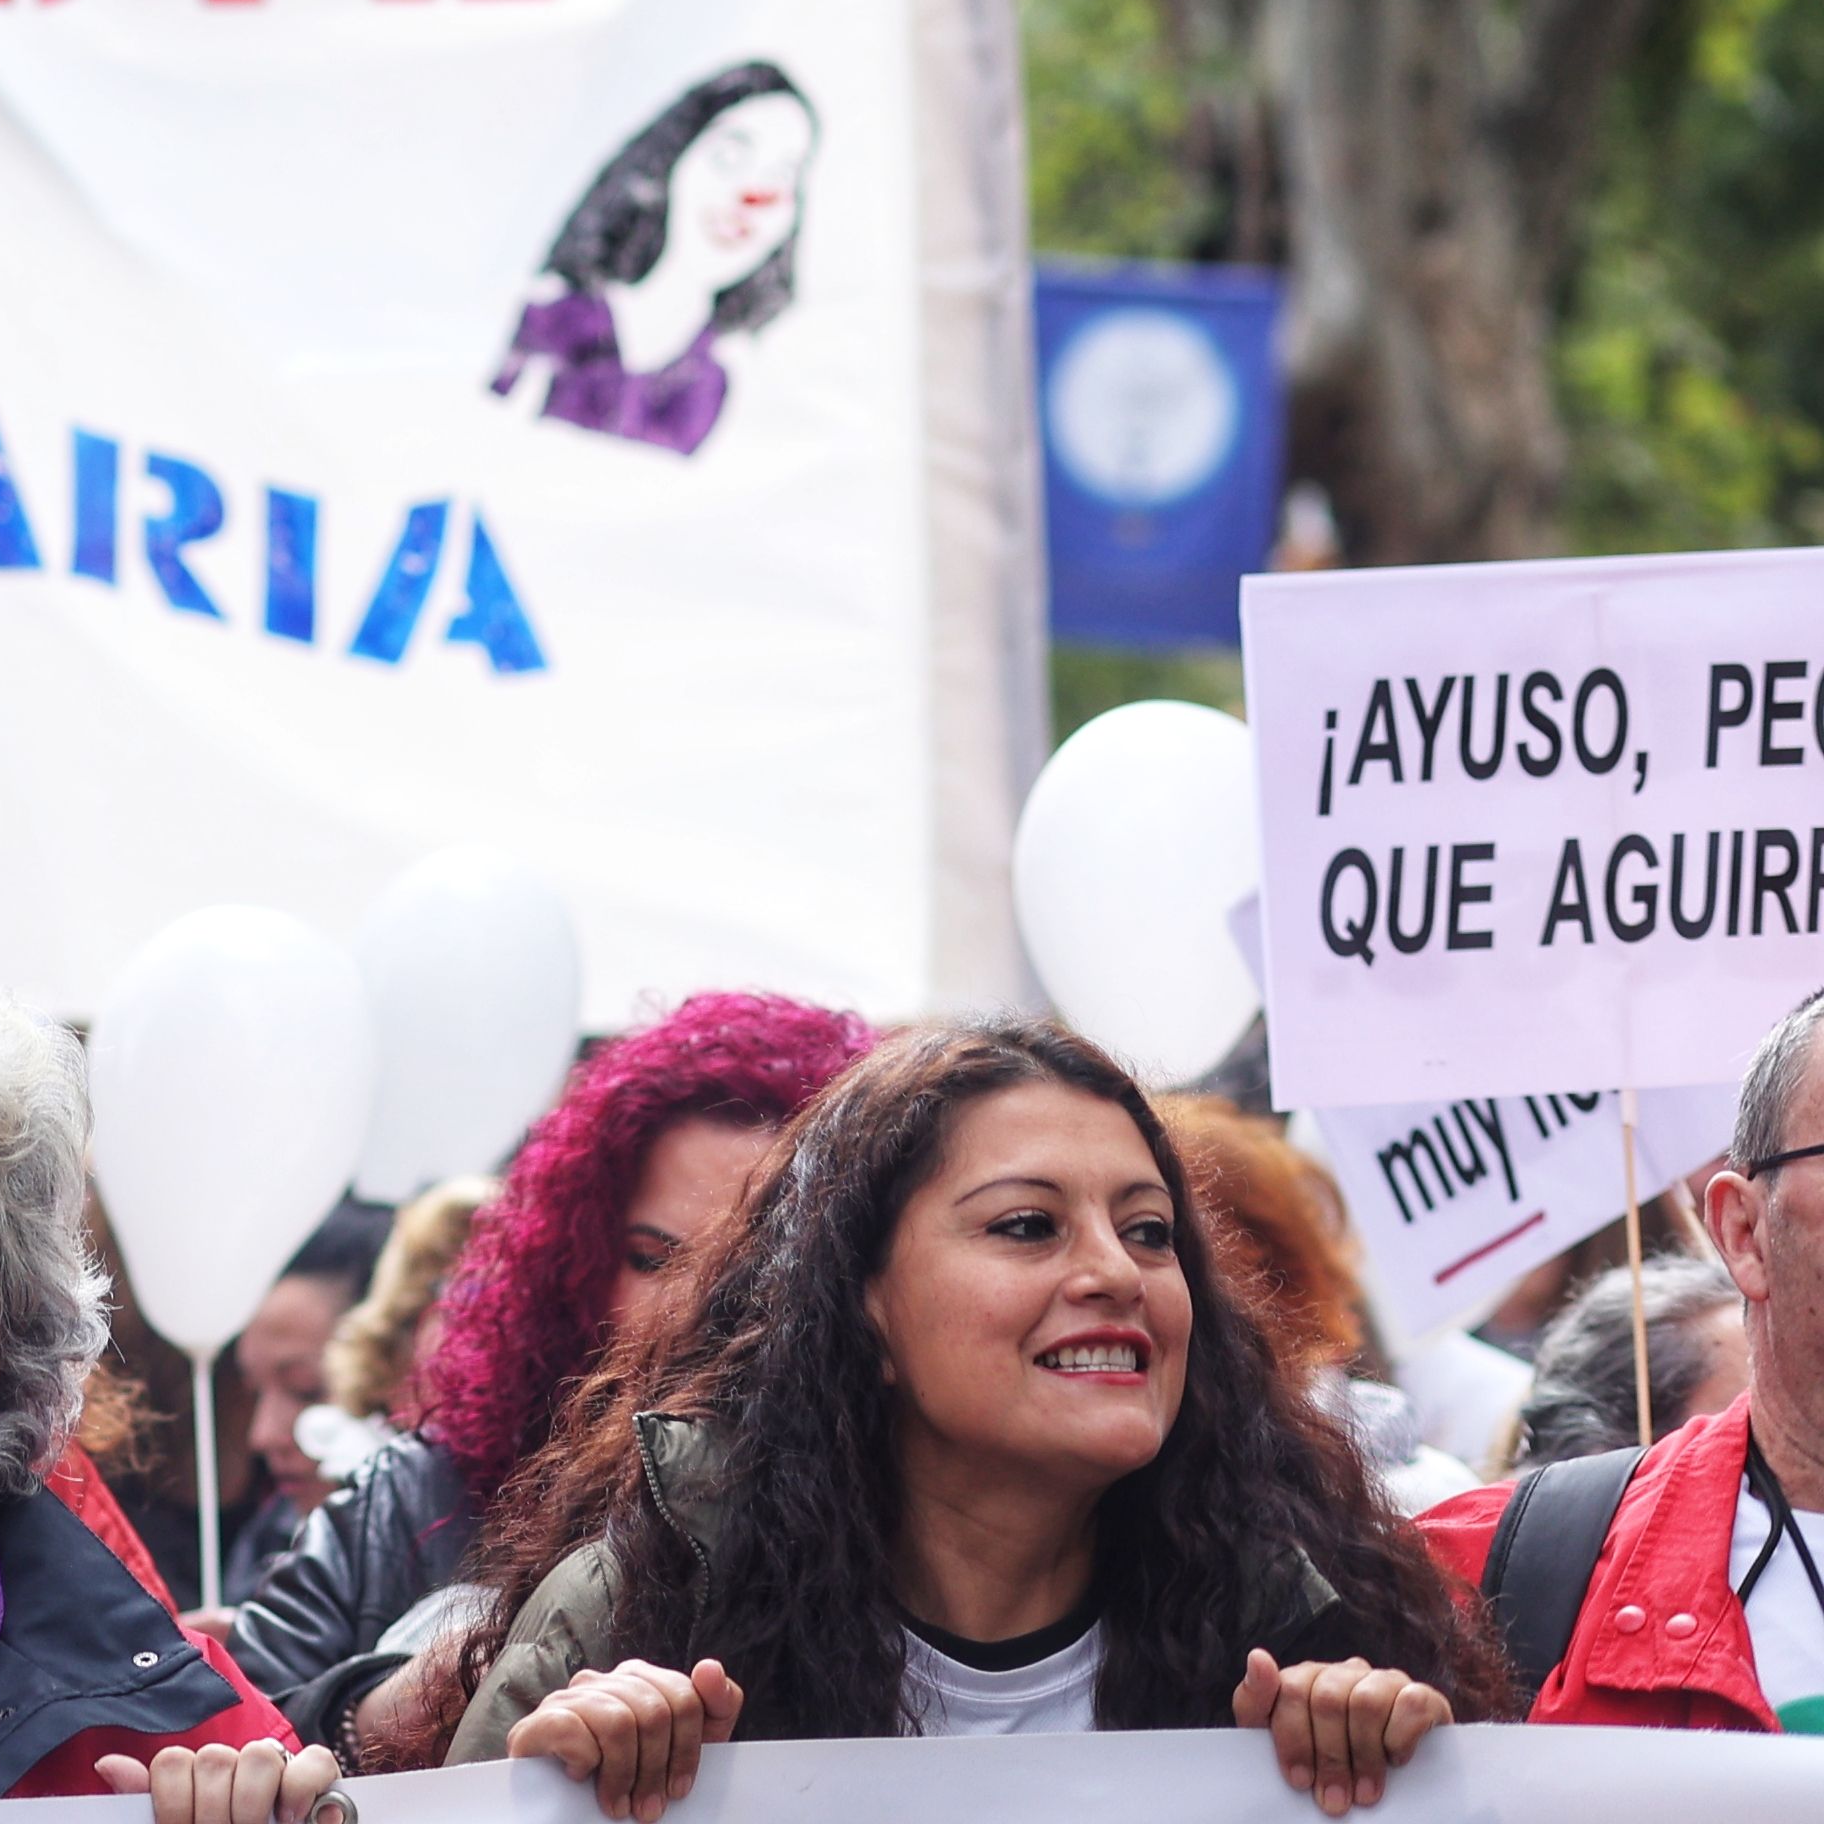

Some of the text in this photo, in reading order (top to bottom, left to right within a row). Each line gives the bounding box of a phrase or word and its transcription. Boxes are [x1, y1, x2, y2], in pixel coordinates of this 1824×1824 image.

[1318, 660, 1824, 817] ¡AYUSO, PE
[1320, 841, 1496, 967] QUE
[1376, 1095, 1520, 1224] muy
